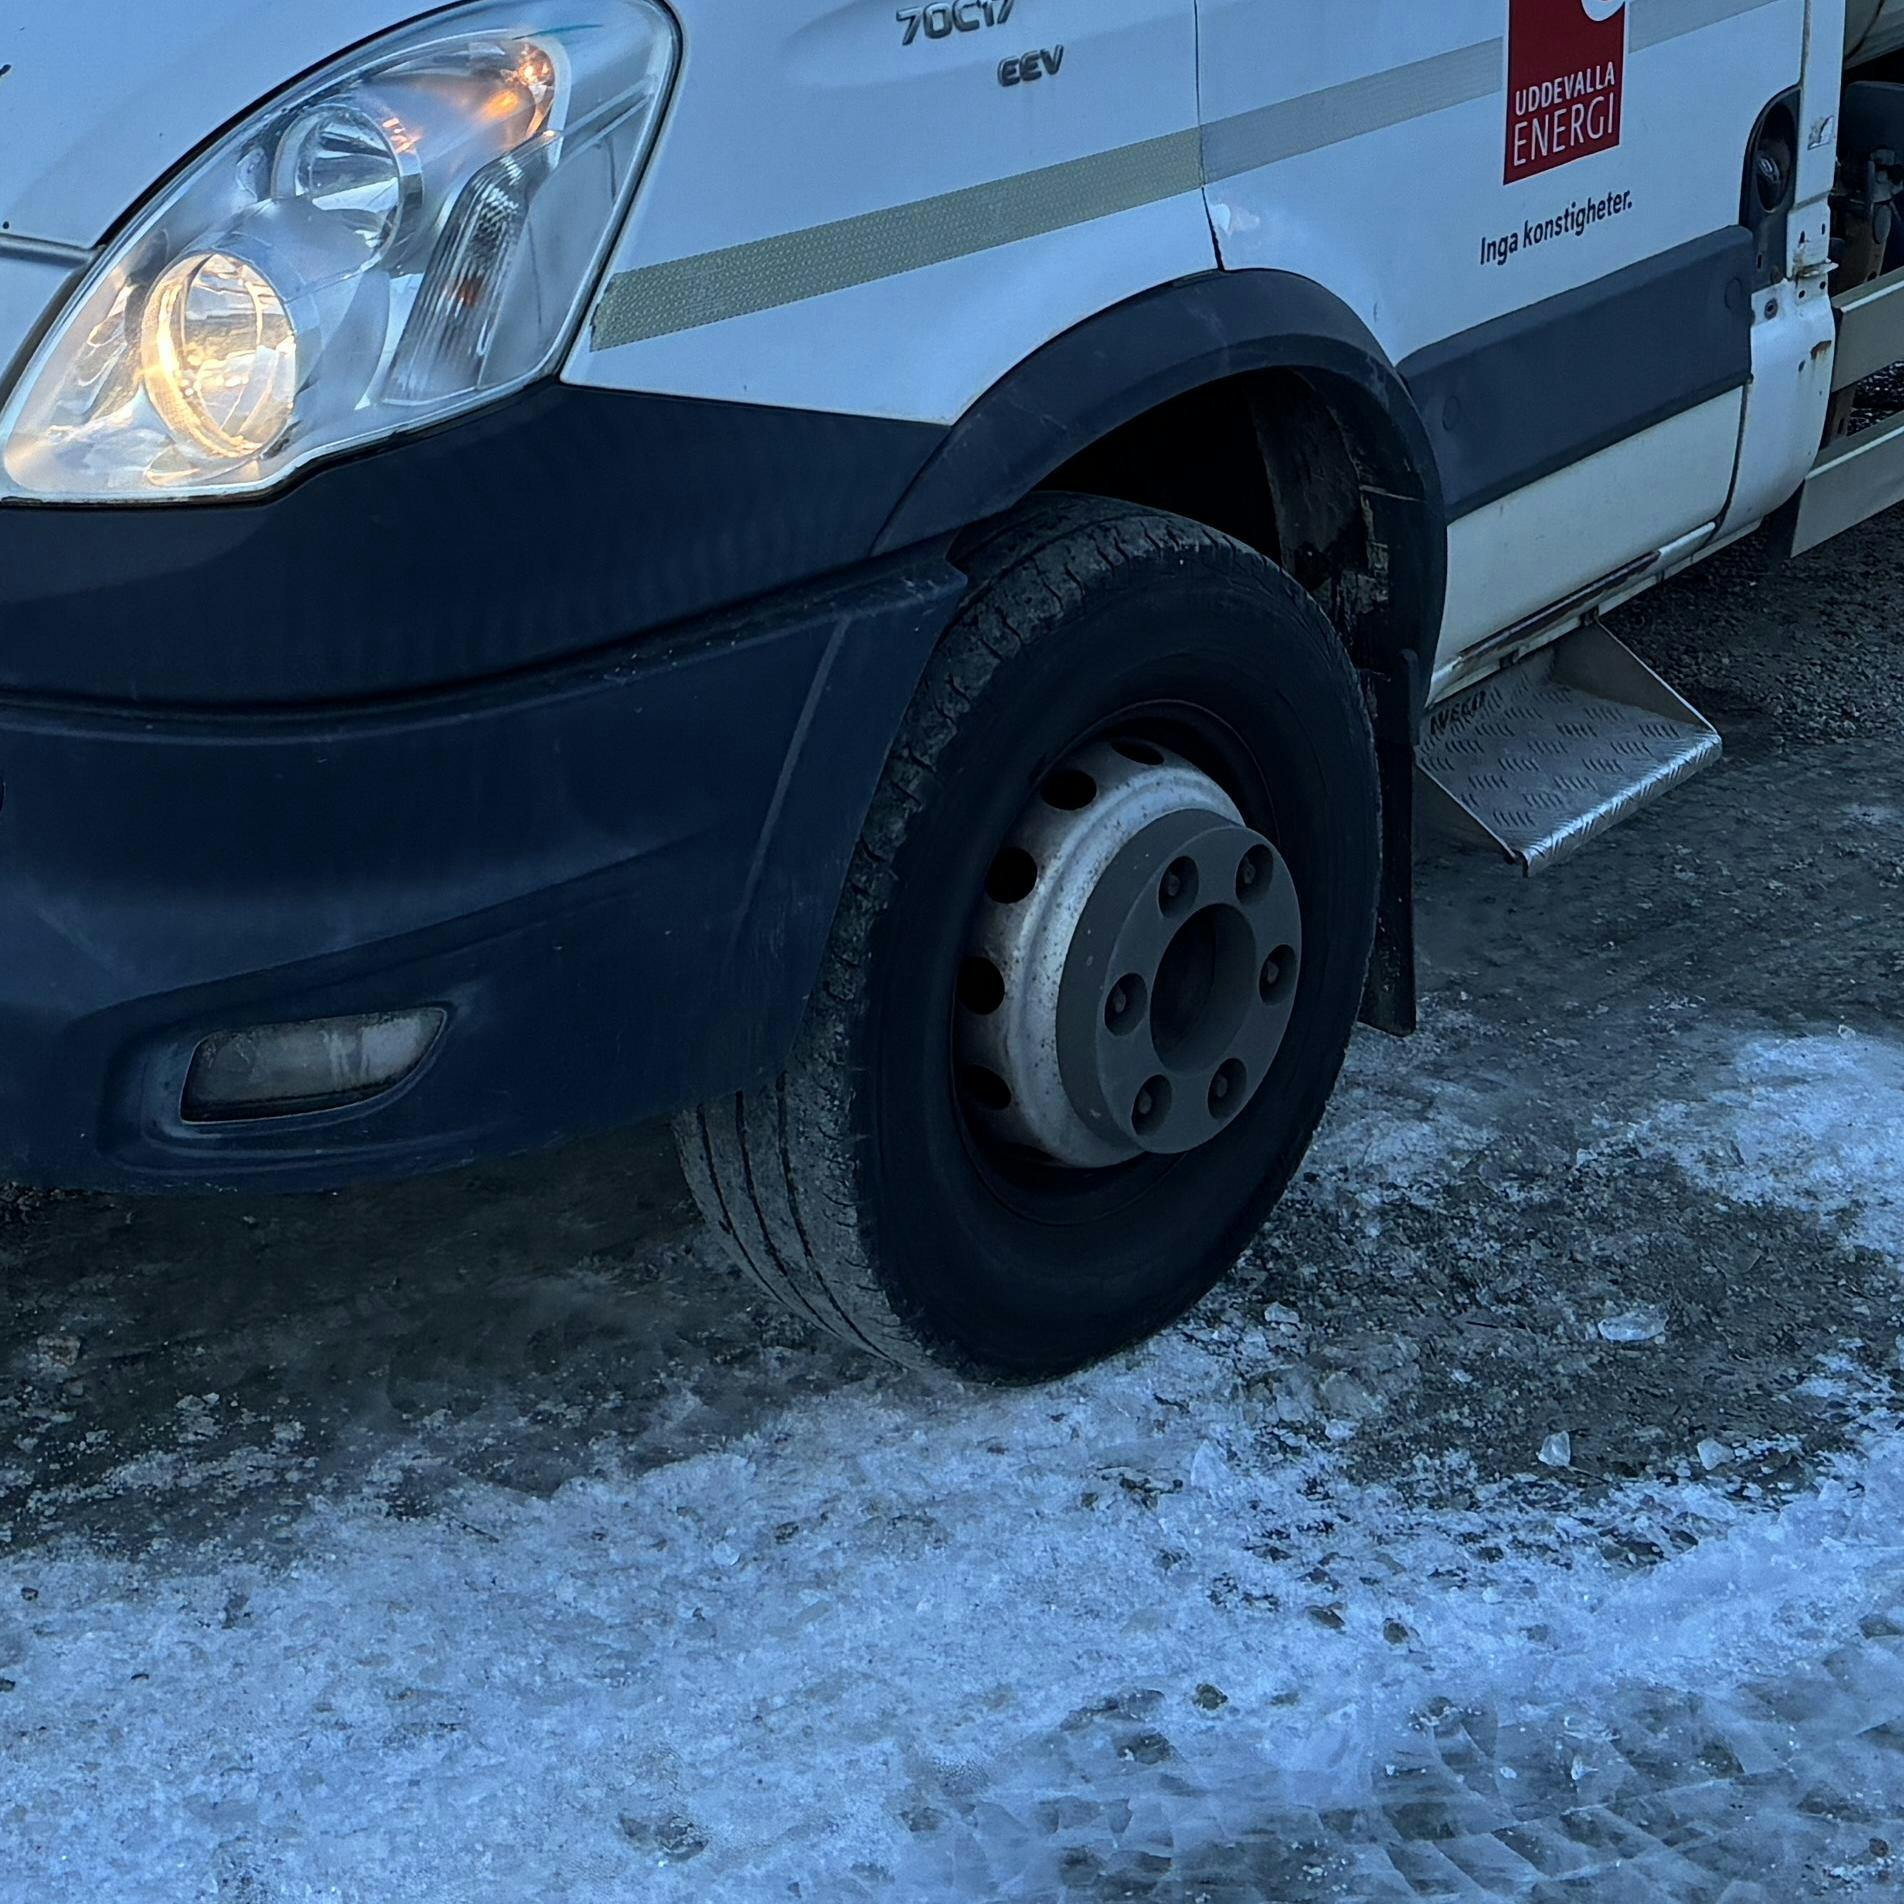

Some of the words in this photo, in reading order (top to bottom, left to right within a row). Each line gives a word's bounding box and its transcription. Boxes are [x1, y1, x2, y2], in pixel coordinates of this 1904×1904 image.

[997, 44, 1064, 87] EEV
[1514, 61, 1615, 117] UDDEVALLA
[1513, 92, 1614, 167] ENERGI
[1480, 234, 1518, 266] Inga
[1523, 190, 1633, 247] konstigheter.
